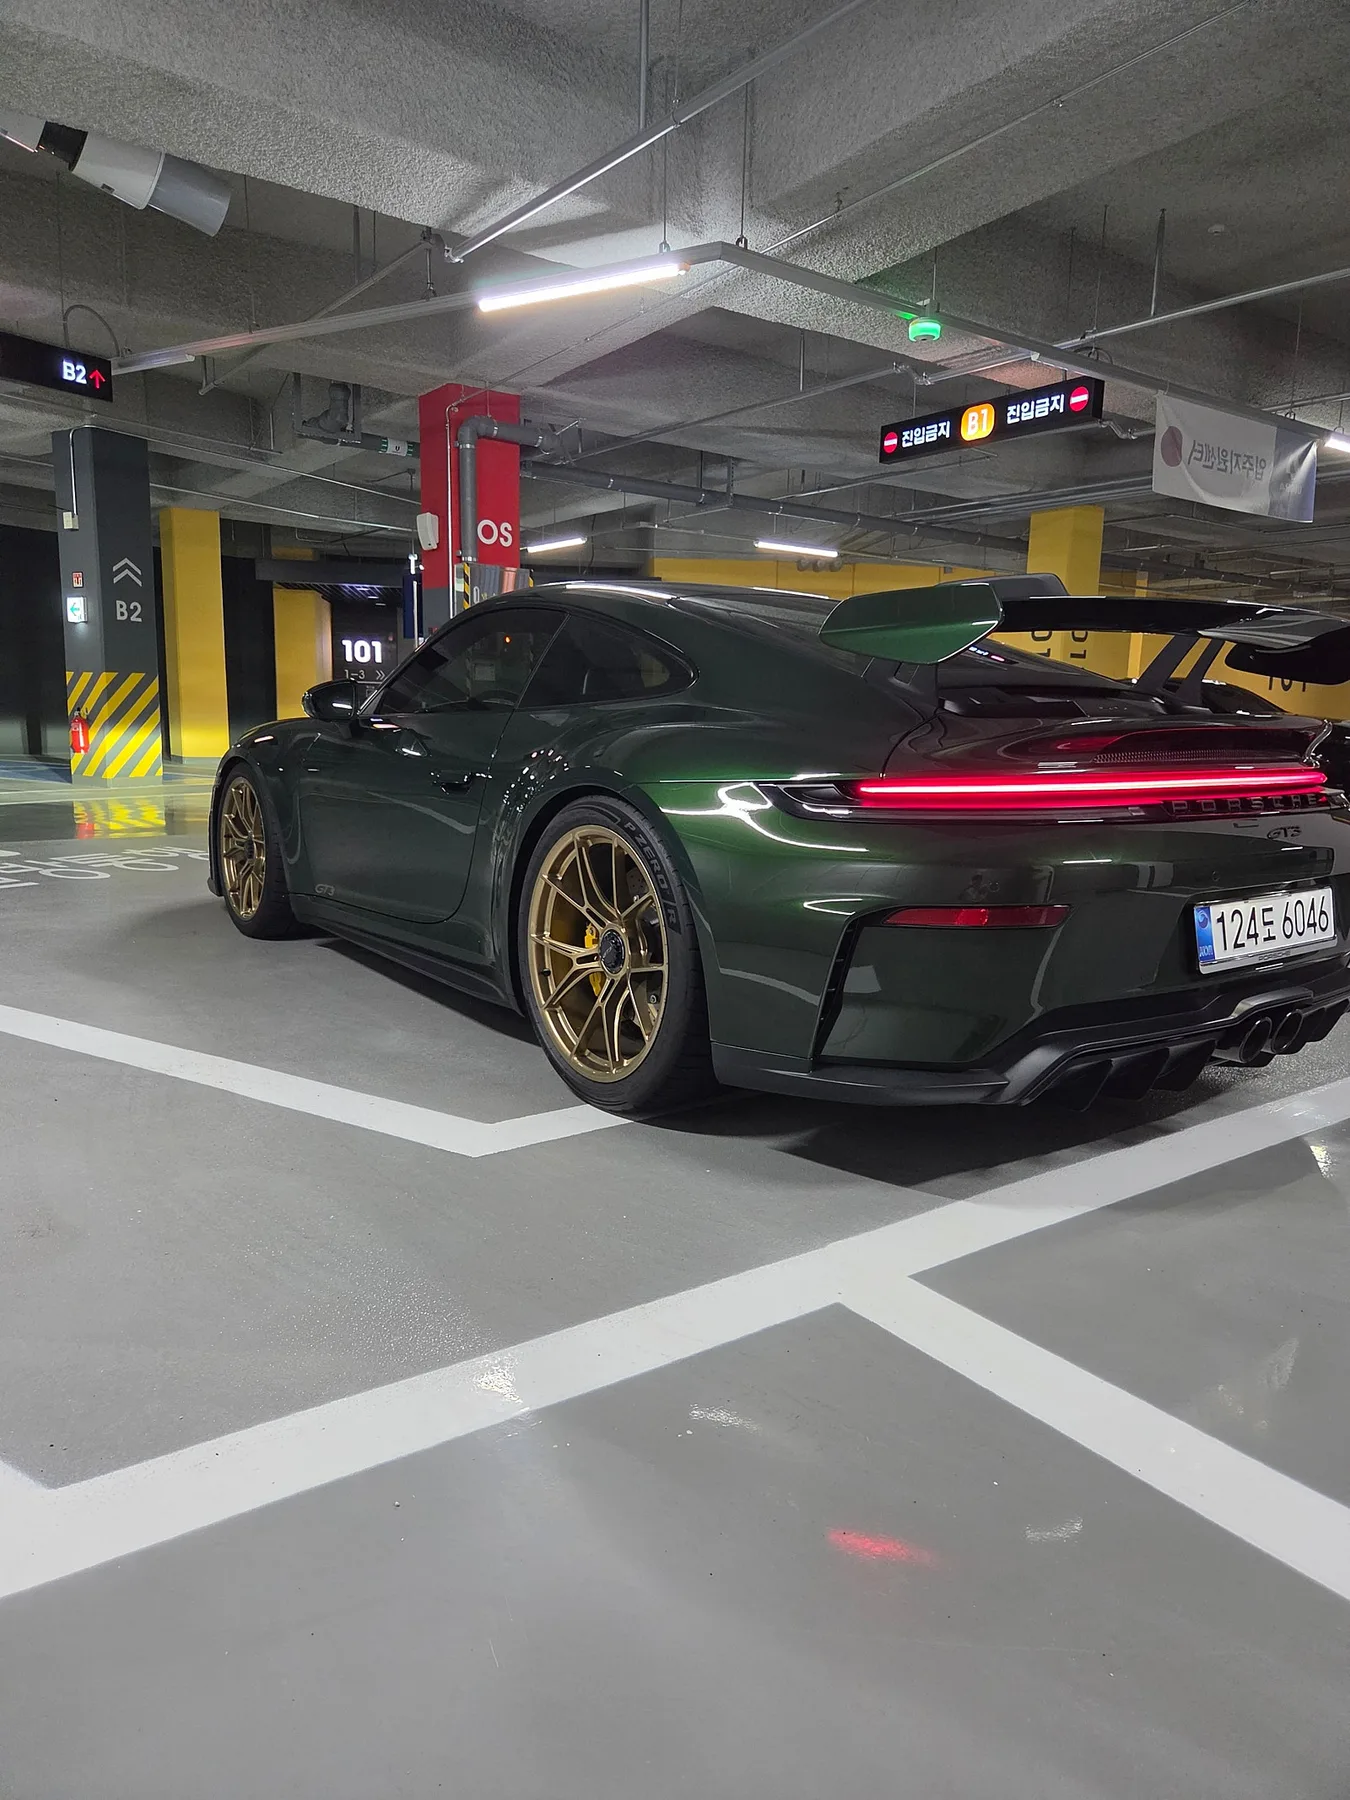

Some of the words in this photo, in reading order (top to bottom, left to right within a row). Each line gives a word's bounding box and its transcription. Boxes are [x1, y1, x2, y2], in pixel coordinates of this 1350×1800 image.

[63, 360, 87, 384] B2
[902, 421, 950, 447] 진입금지
[966, 408, 988, 436] B1
[1006, 393, 1065, 424] 진입금지
[477, 519, 513, 547] OS
[116, 600, 142, 622] B2
[342, 639, 382, 663] 101
[1172, 794, 1317, 813] PORSCHE
[1216, 906, 1276, 950] 124도
[1282, 896, 1329, 939] 6046
